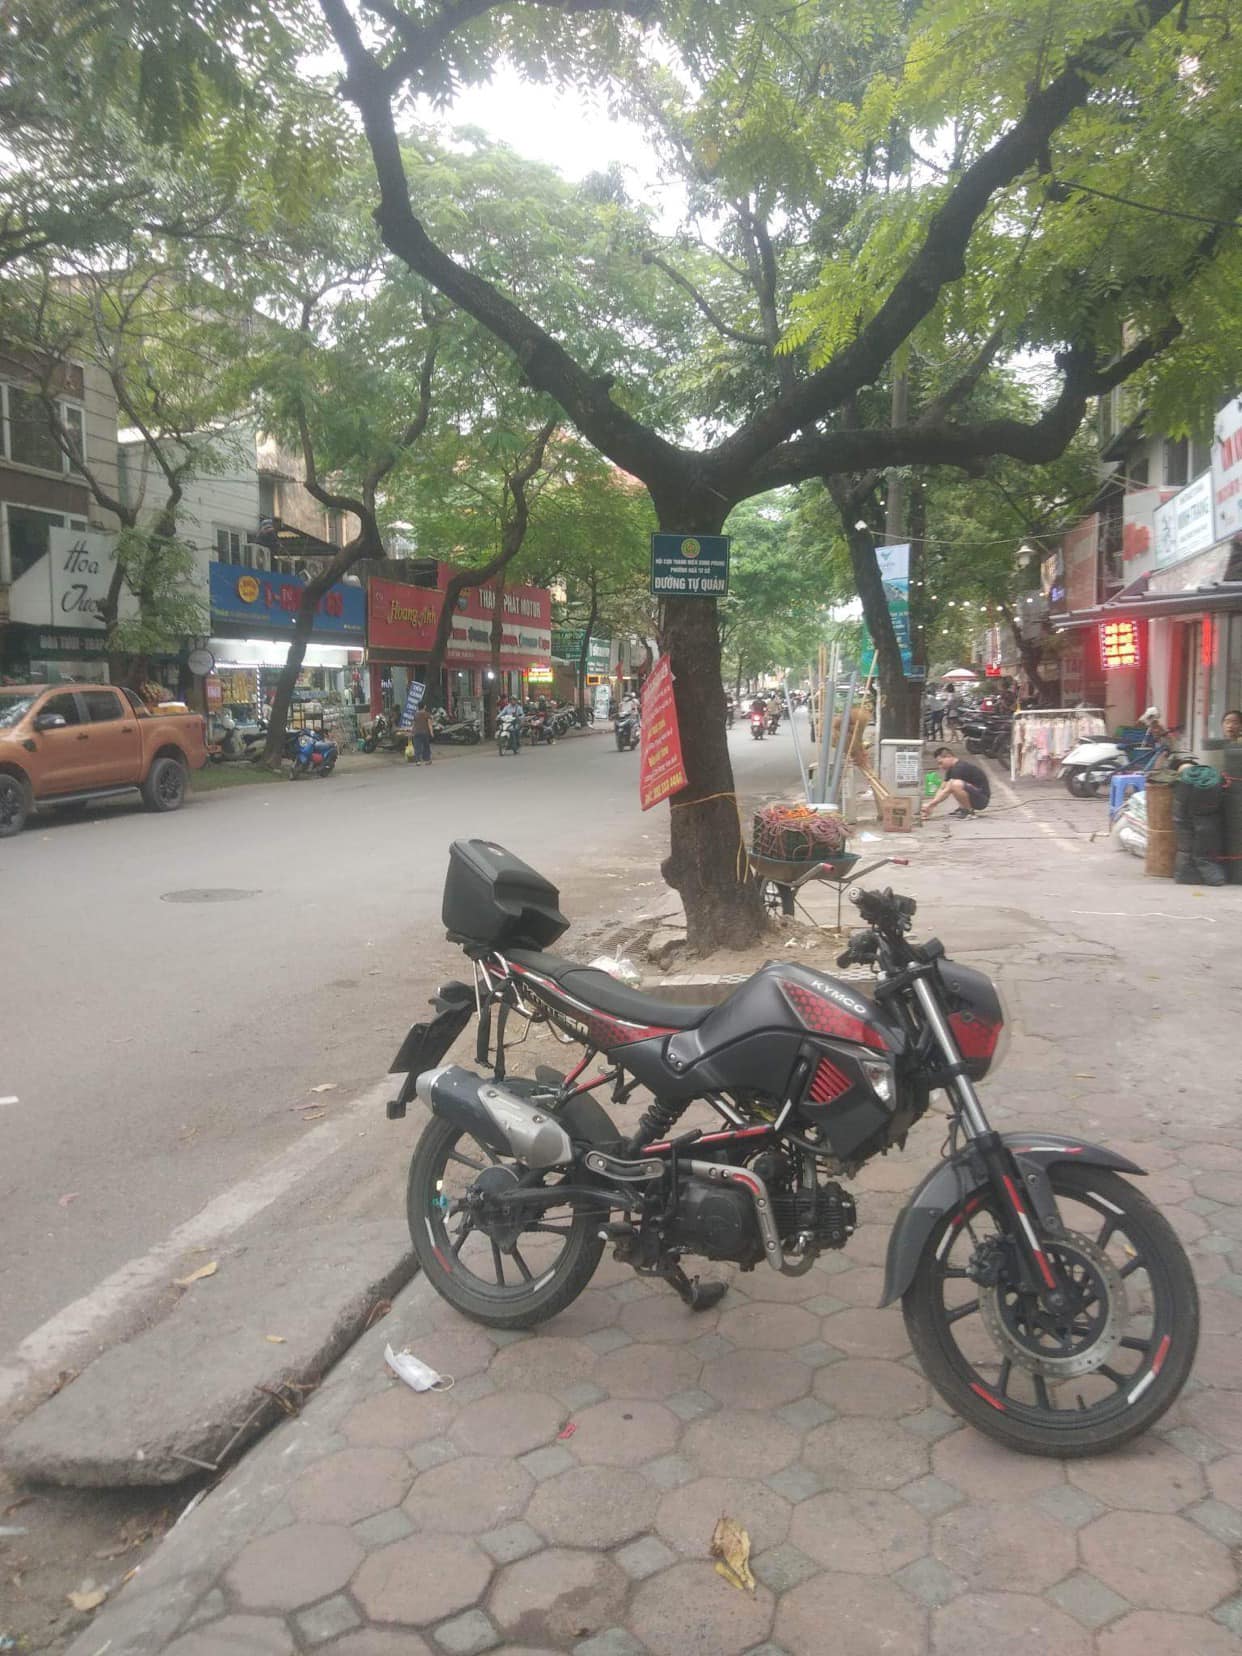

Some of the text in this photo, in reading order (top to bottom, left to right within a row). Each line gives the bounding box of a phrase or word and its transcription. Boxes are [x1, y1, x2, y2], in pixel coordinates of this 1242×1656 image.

[63, 540, 98, 575] Hoa
[654, 574, 725, 592] ĐƯỜNG TỰ QUẢN
[811, 979, 867, 1014] KYMCO
